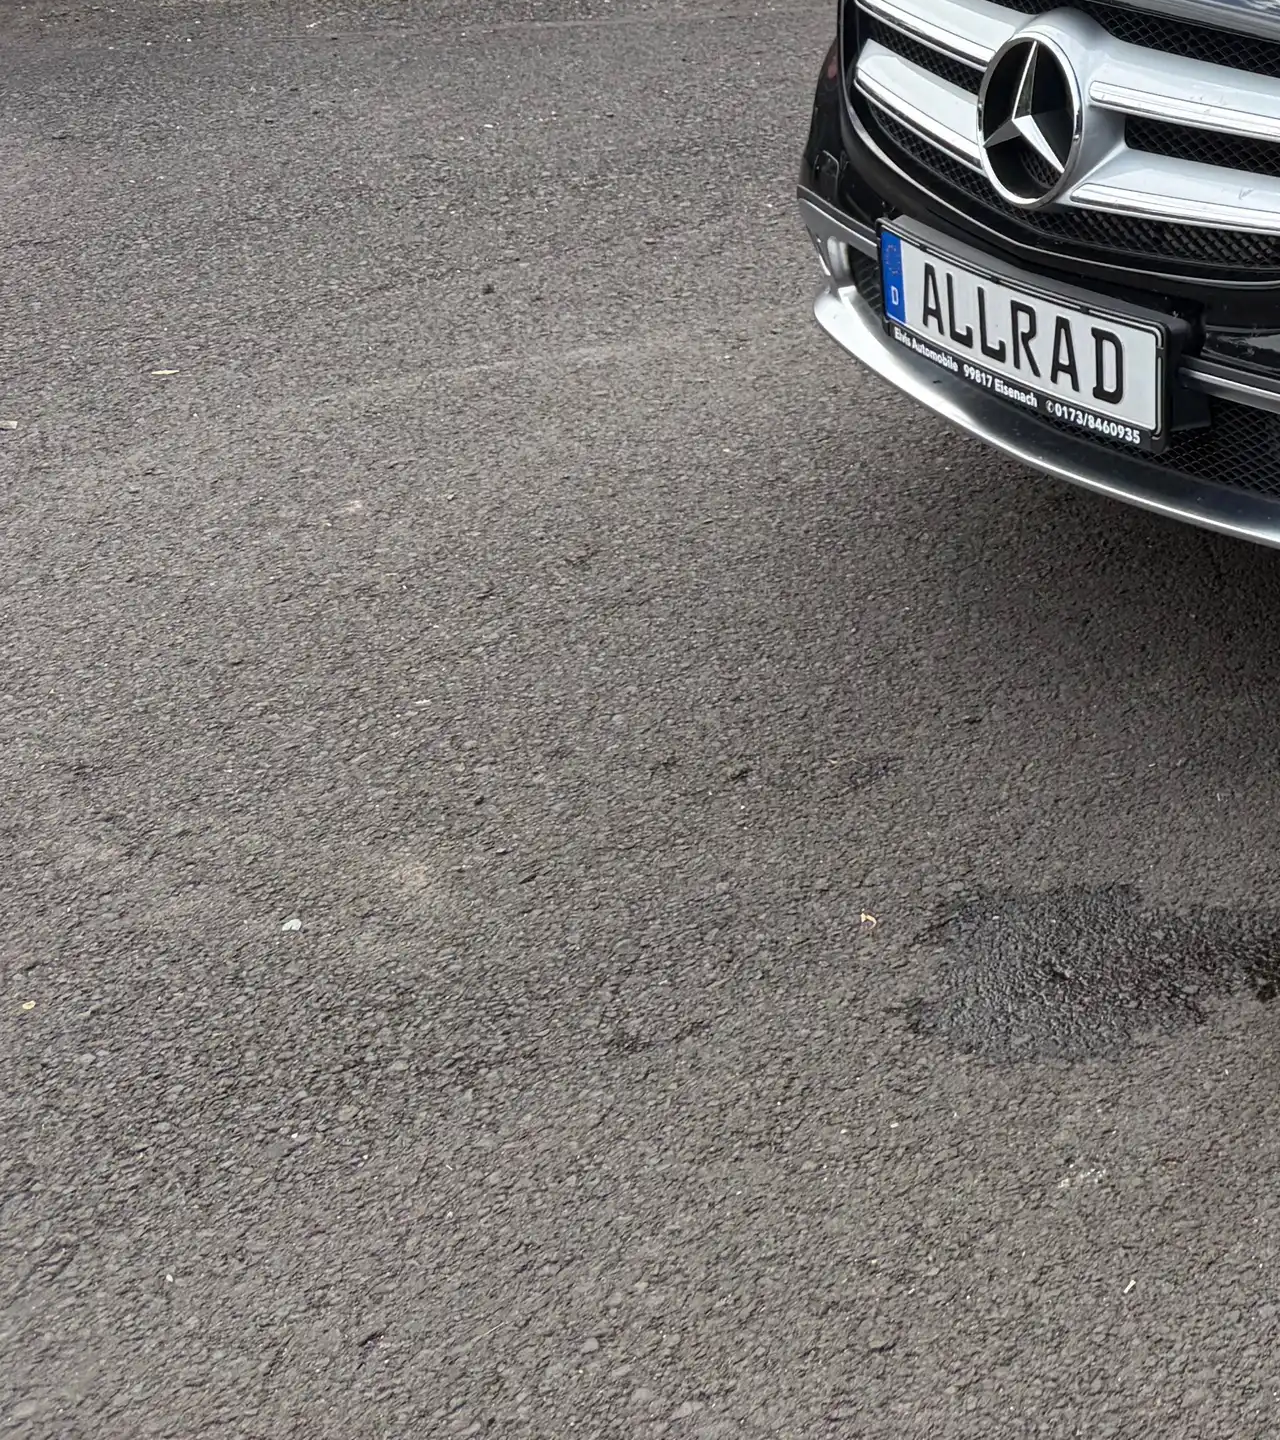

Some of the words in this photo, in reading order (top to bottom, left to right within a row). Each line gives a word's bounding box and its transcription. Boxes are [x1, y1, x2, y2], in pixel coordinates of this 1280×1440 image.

[891, 285, 899, 307] D
[922, 262, 1124, 405] ALLRAD
[893, 326, 912, 349] Elvis
[911, 335, 959, 373] Automobile
[963, 363, 993, 389] 99817
[994, 379, 1038, 408] Eisenach
[1054, 402, 1141, 445] 0173/8460935
